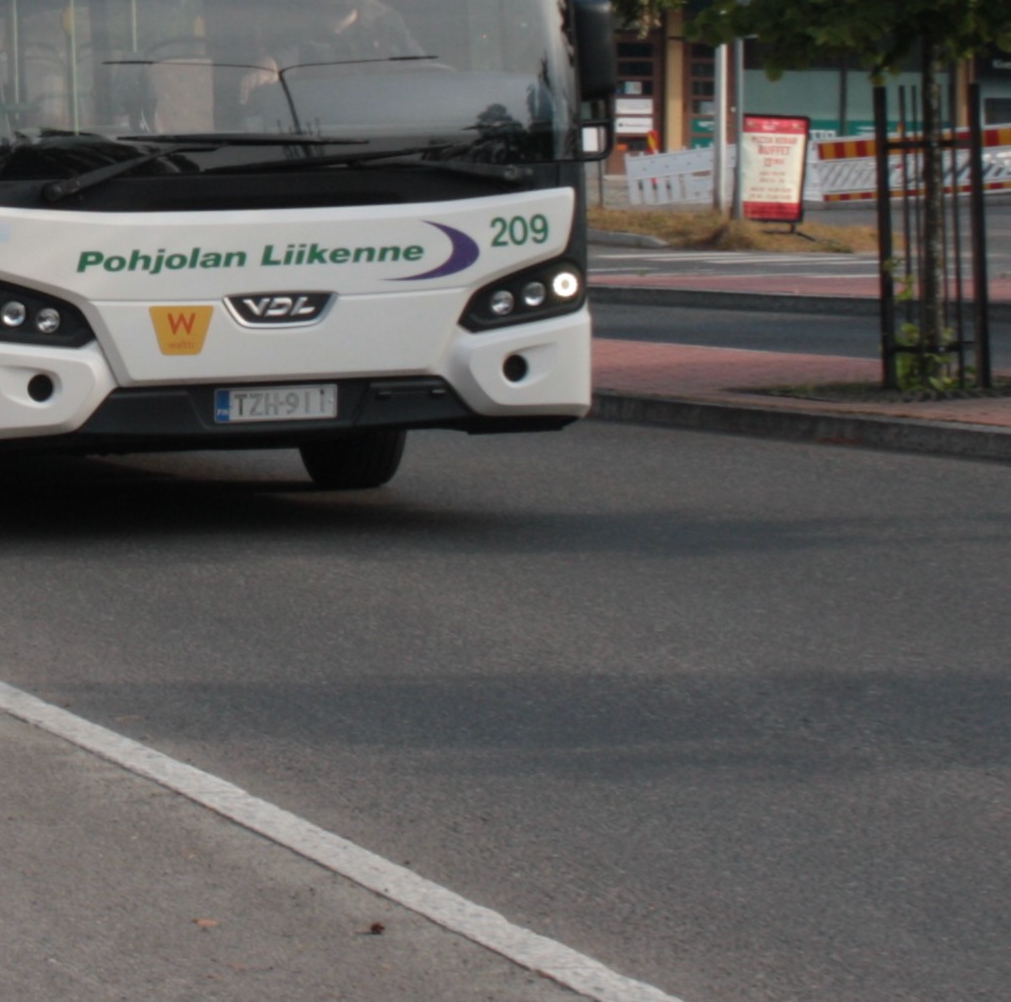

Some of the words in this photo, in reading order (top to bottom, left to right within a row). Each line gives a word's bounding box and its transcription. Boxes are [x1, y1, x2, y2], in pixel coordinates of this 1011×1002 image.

[490, 214, 549, 247] 209
[76, 247, 247, 275] Pohjolan
[260, 243, 424, 267] Liikenne
[242, 296, 316, 317] VDL
[167, 312, 196, 335] W
